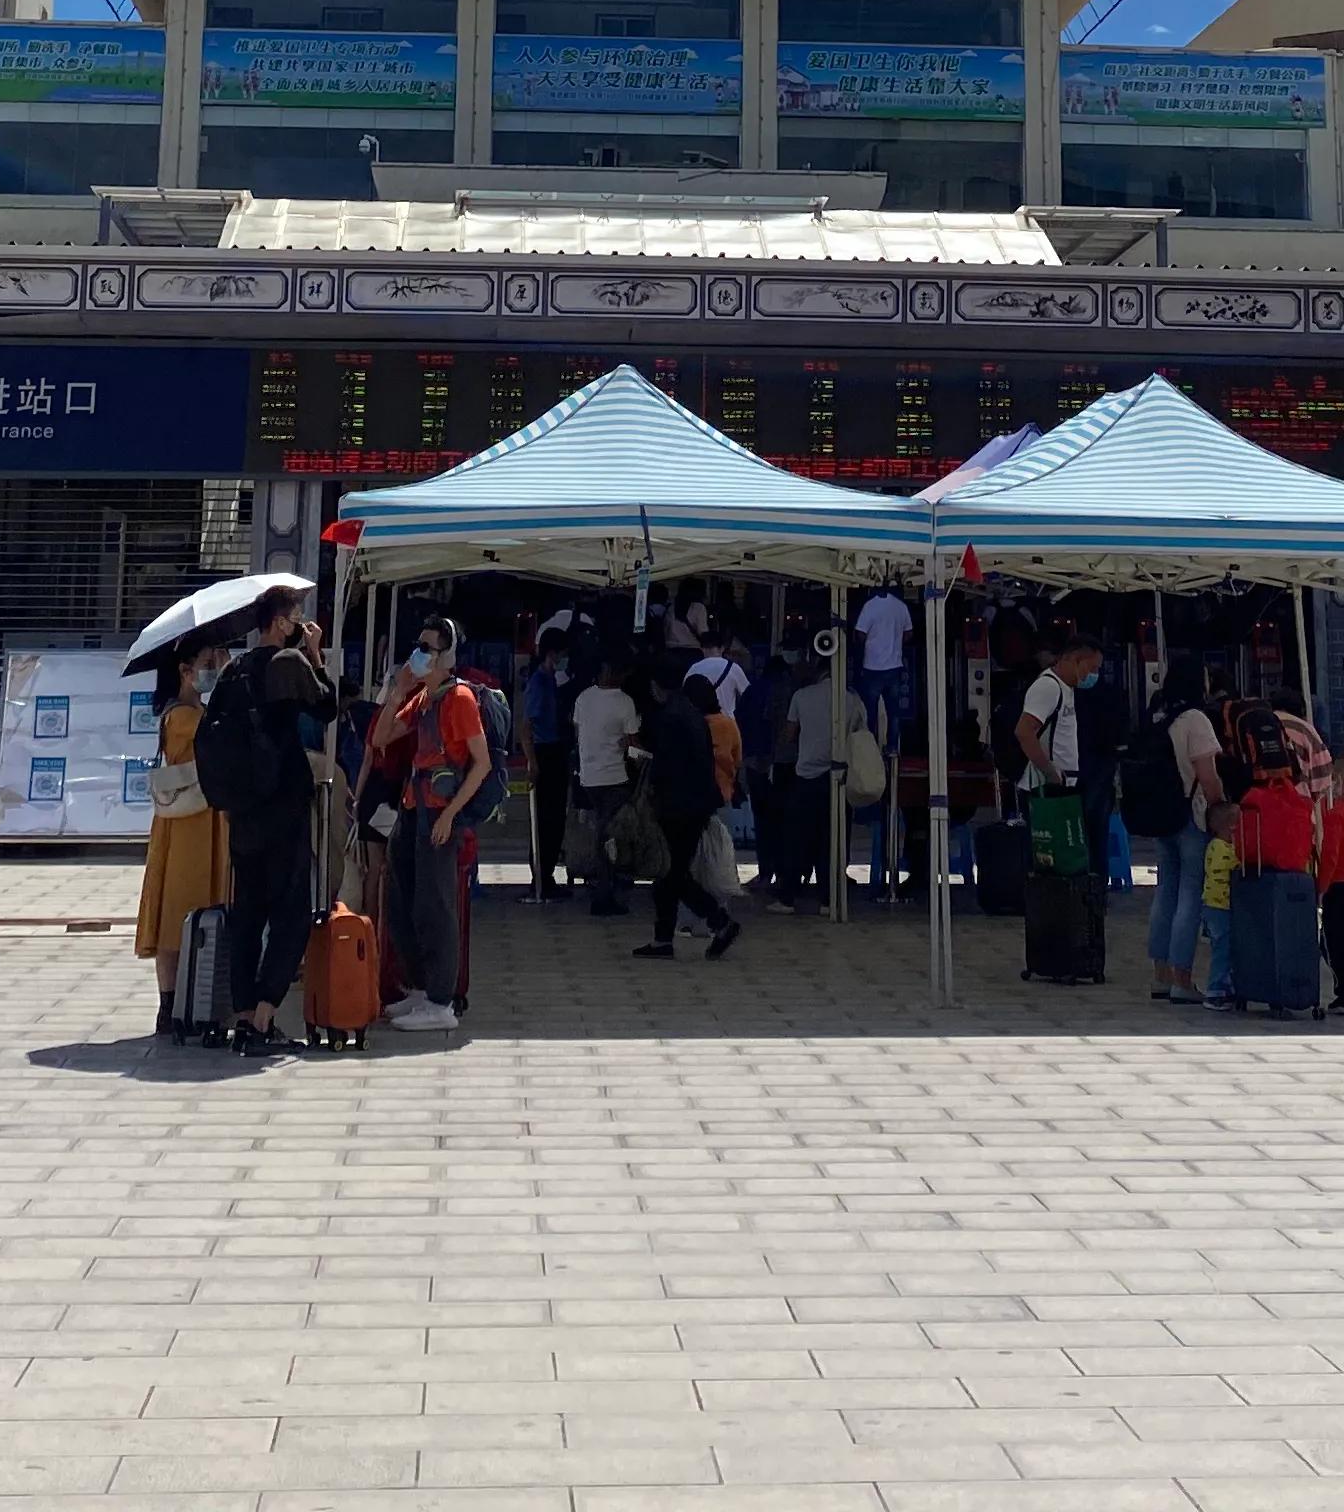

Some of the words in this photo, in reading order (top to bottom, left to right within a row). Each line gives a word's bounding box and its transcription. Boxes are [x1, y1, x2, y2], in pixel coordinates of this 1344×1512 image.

[235, 39, 401, 56] 推进爱国卫生专项行动
[514, 46, 690, 67] 人人参与环境治理
[252, 58, 416, 74] 共建共享国家卫生城市
[808, 51, 961, 72] 爱国卫生你我他
[261, 77, 424, 93] 全面改善城乡人居环境
[537, 71, 710, 90] 天天享受健康生活
[838, 76, 991, 95] 健康生活靠大家
